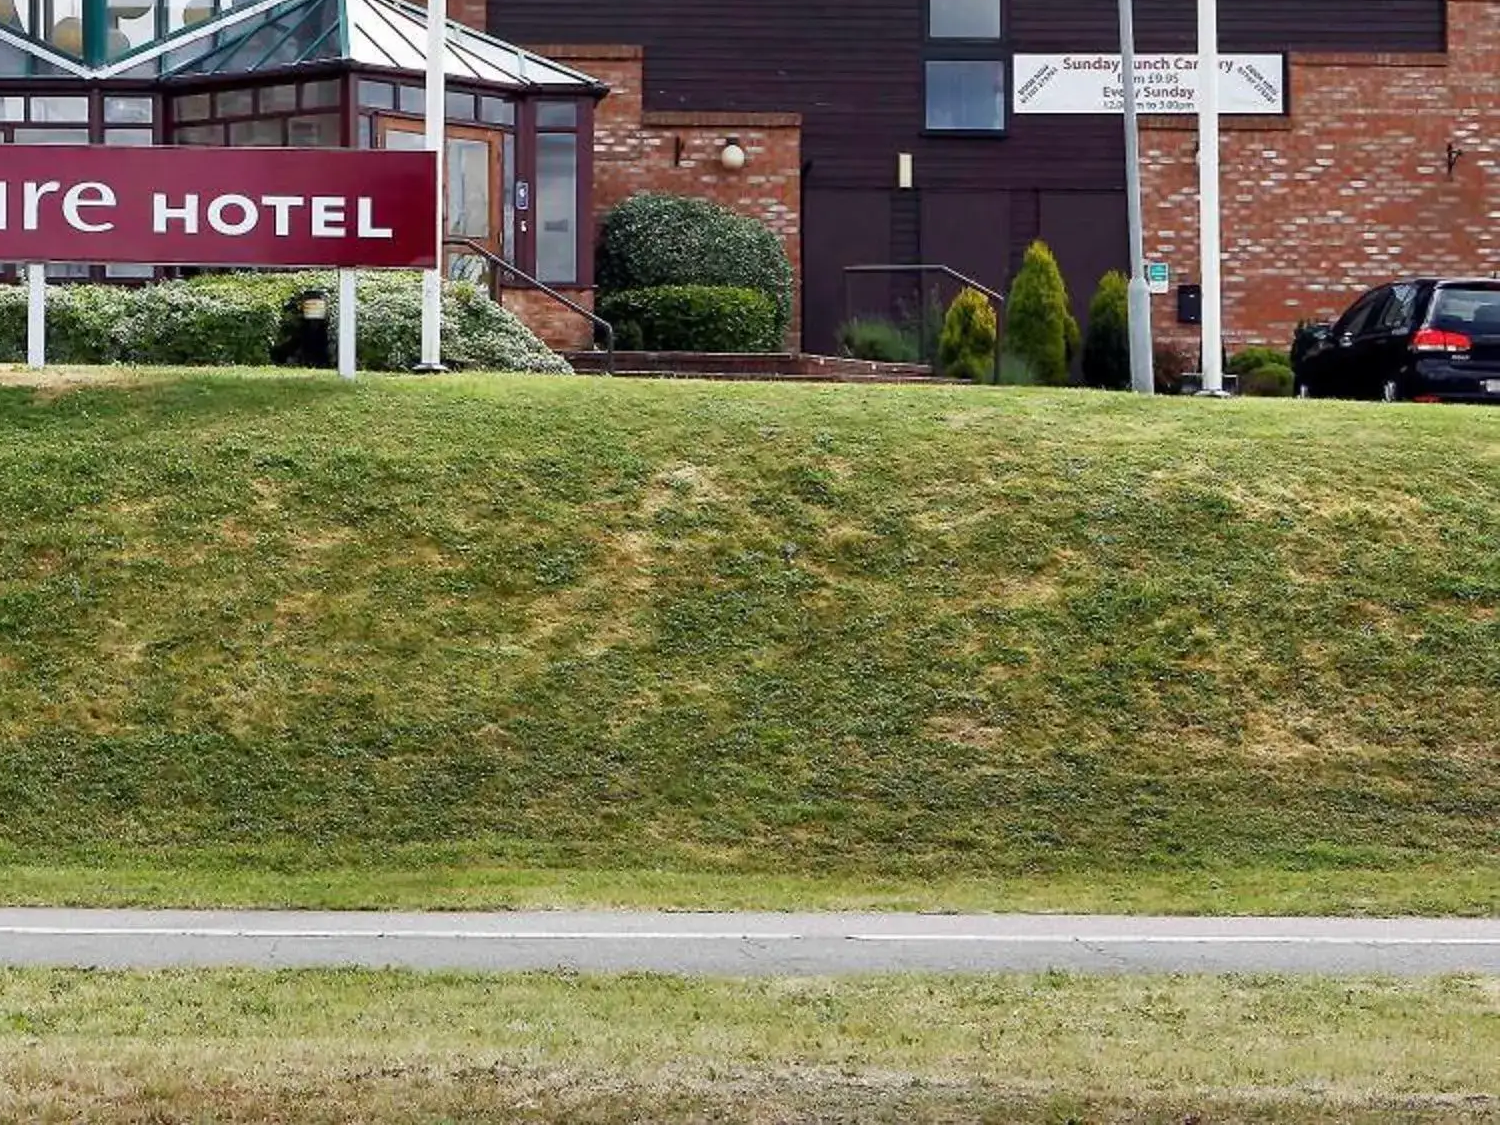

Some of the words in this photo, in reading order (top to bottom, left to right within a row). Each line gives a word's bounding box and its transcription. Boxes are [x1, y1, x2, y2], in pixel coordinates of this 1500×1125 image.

[1063, 57, 1120, 74] Sunday
[1122, 56, 1171, 70] unch
[1173, 57, 1233, 74] Carry
[1117, 73, 1145, 84] fm
[1103, 86, 1141, 99] Evey
[1143, 86, 1195, 100] Sunday
[153, 193, 394, 238] HOTEL
